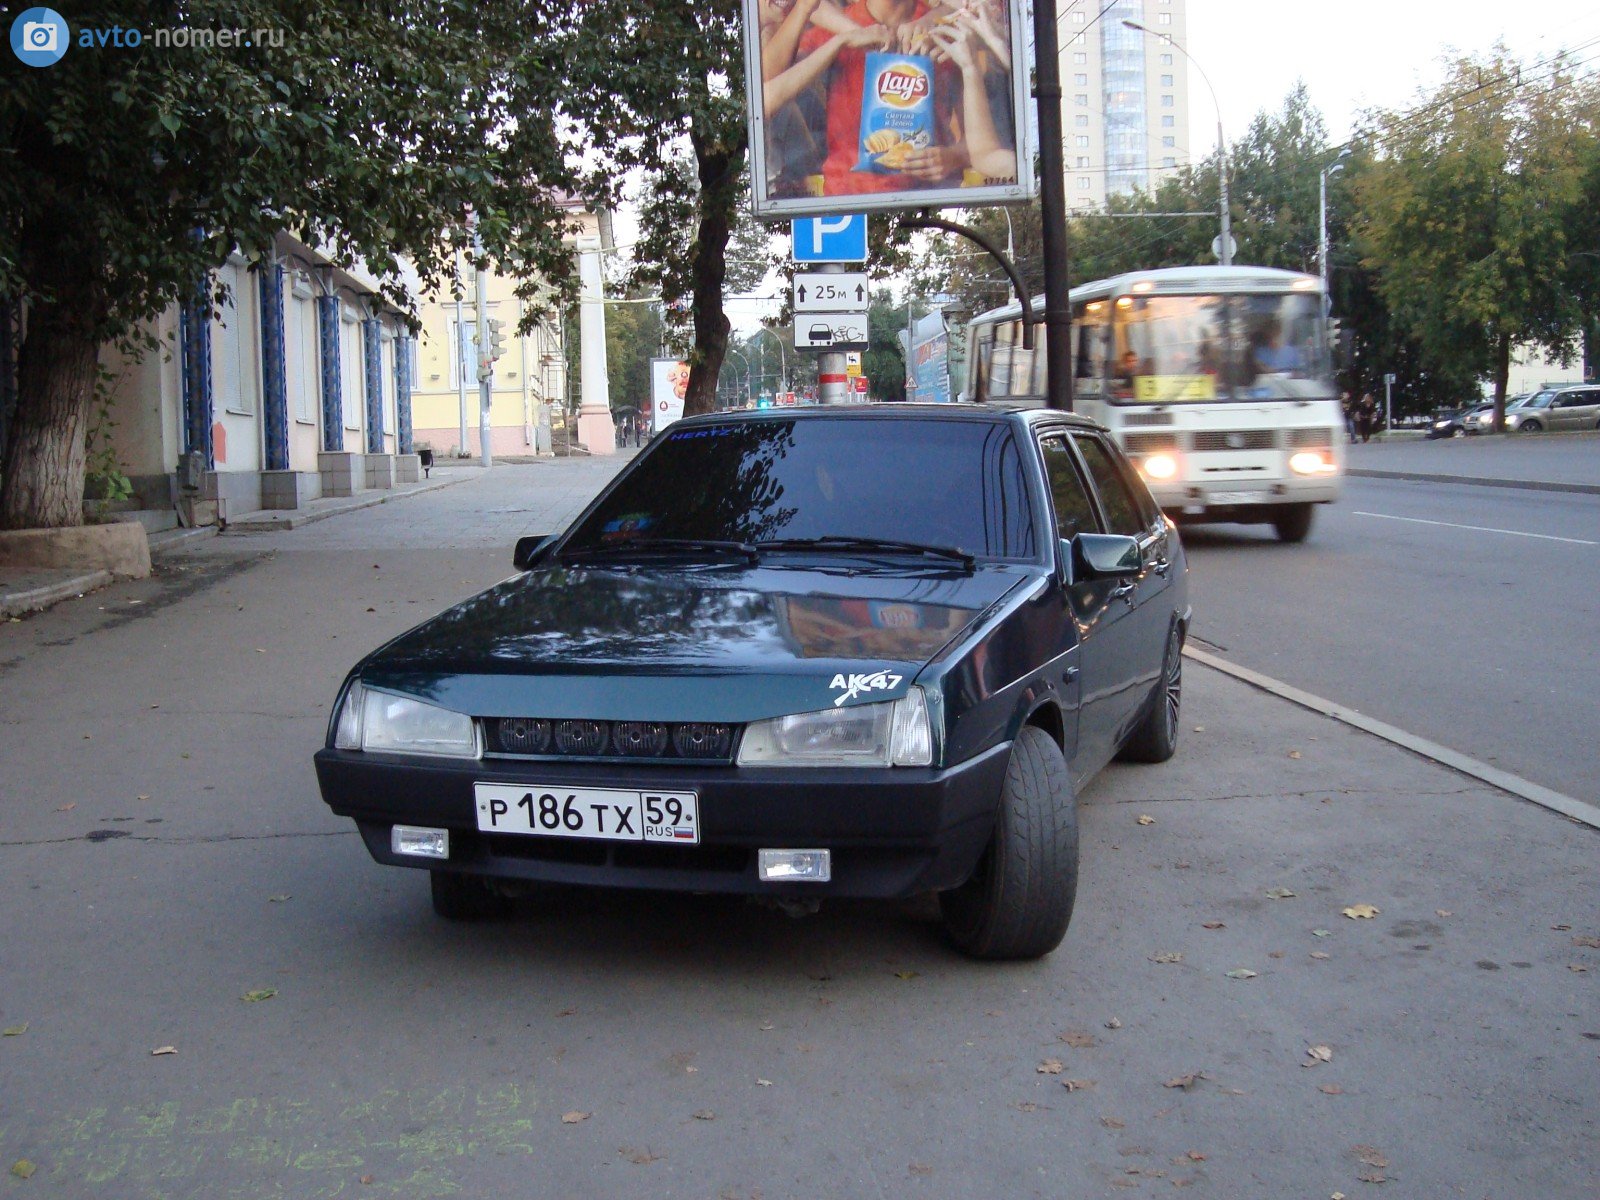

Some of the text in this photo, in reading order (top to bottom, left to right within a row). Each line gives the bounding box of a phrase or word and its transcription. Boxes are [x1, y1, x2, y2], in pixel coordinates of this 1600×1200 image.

[881, 72, 925, 100] Lay's
[646, 796, 683, 826] 59
[646, 825, 673, 837] RUS
